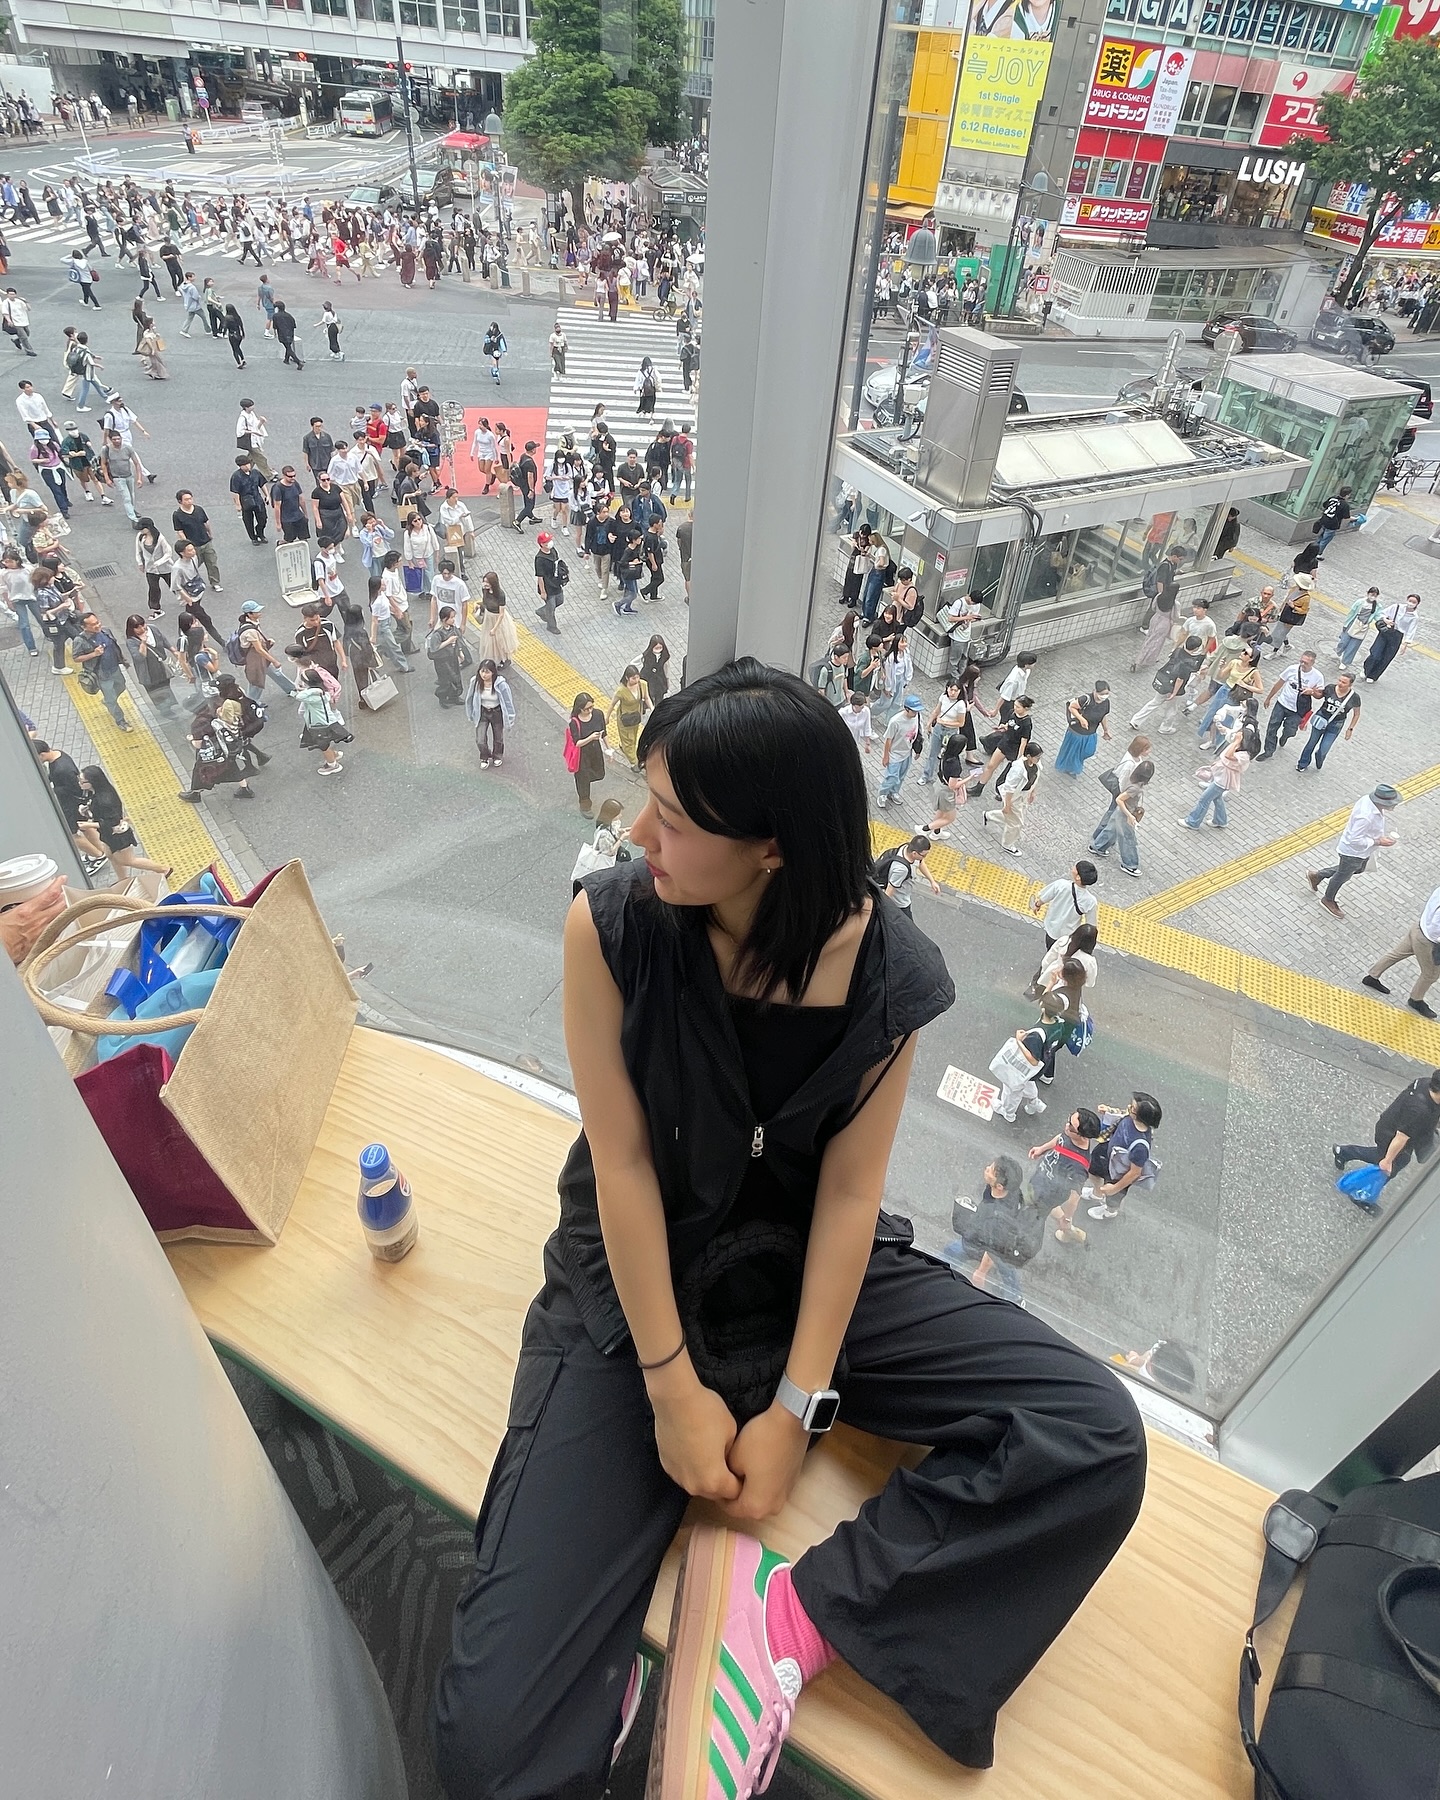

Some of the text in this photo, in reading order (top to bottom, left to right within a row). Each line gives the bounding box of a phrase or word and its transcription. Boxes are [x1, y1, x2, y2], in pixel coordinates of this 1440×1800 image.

[1108, 0, 1189, 25] AGA
[1202, 14, 1328, 51] クリニック
[1100, 47, 1131, 83] 薬
[978, 90, 1020, 104] 1st Single
[1092, 88, 1151, 104] DRUG & COSMETIC
[1088, 101, 1149, 122] サンドラッグ
[960, 120, 1027, 138] 6.12 Release!
[961, 136, 975, 144] Sony
[976, 138, 991, 146] Music
[993, 141, 1010, 149] Labels
[1237, 156, 1306, 186] LUSH
[1100, 206, 1149, 221] サンドラッグ
